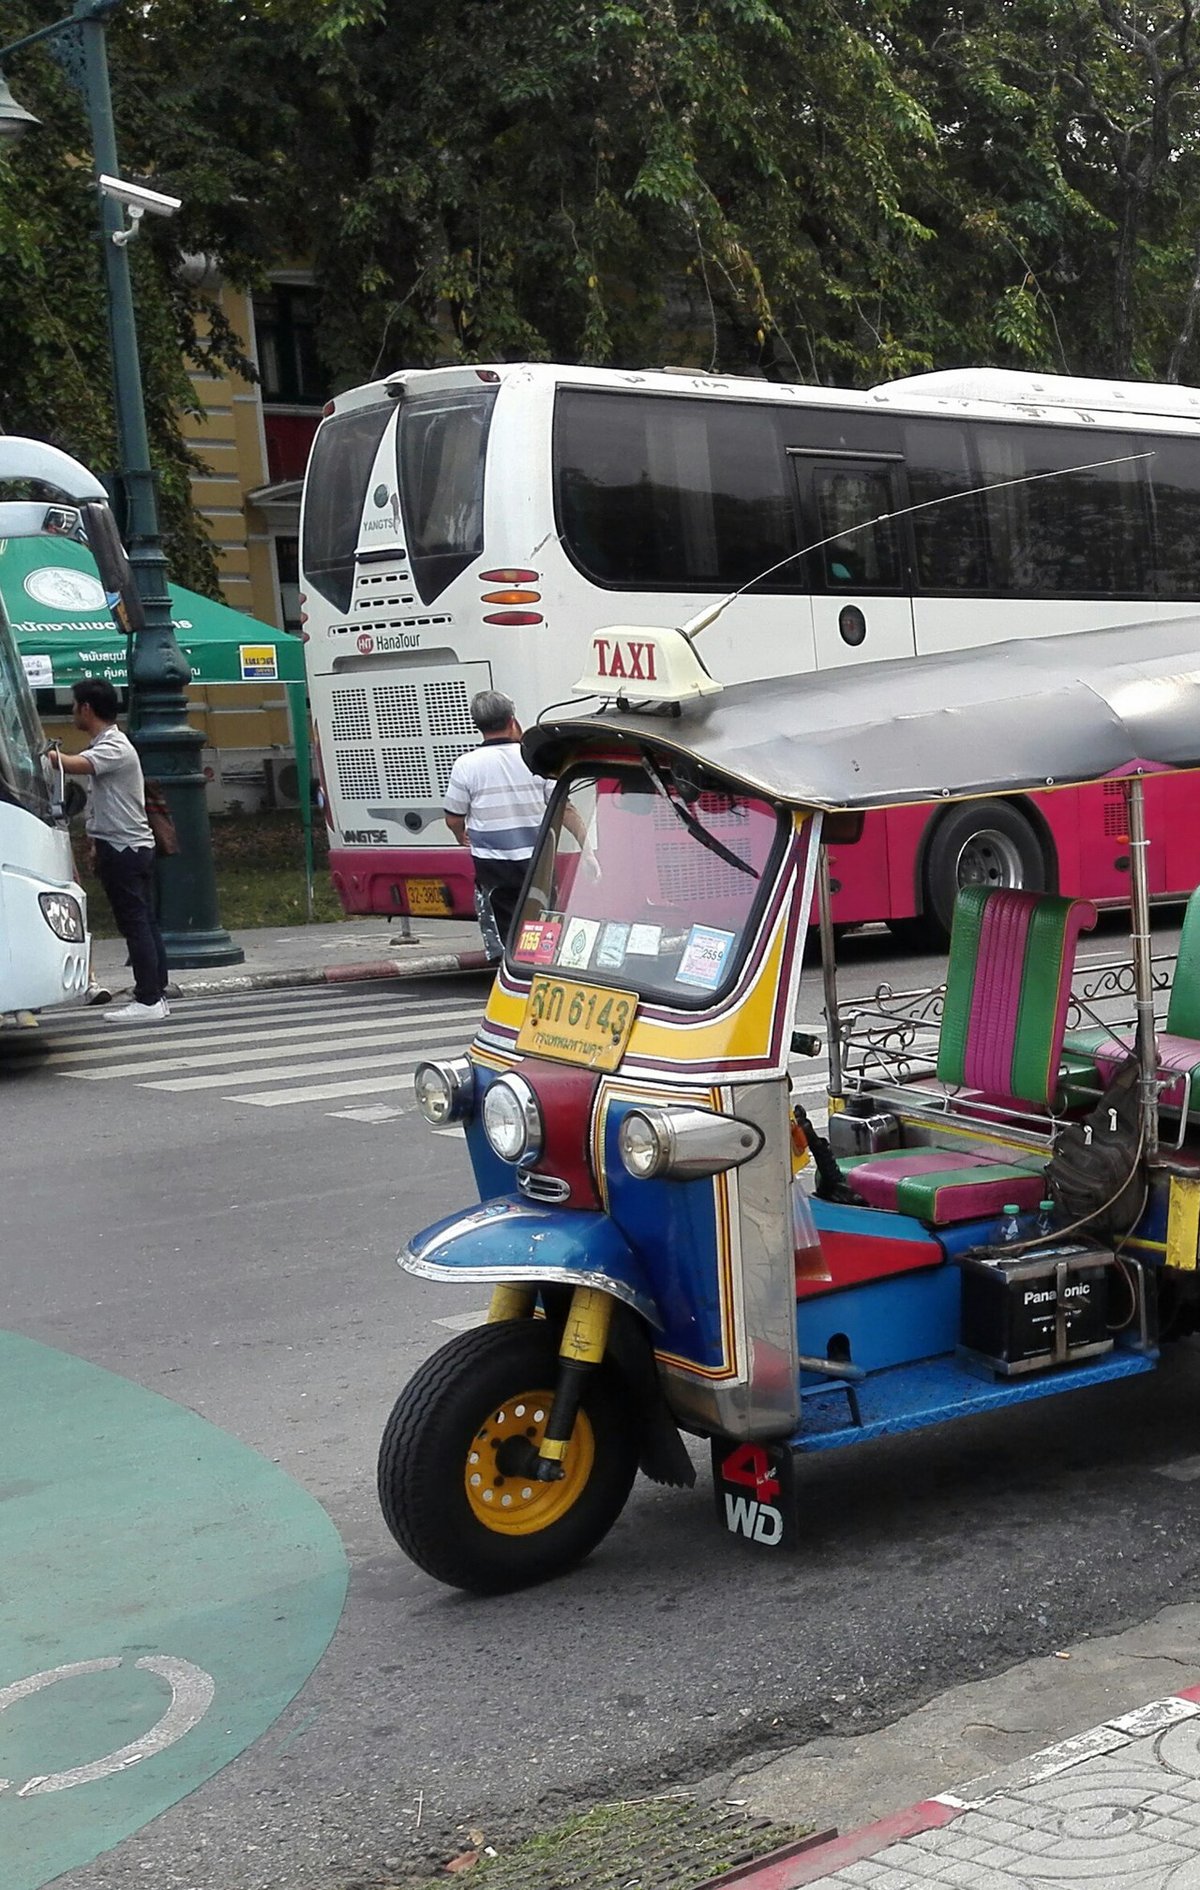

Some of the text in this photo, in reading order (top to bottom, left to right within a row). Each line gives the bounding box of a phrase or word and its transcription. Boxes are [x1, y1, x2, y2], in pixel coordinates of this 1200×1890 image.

[363, 518, 396, 531] YANGTS
[376, 633, 421, 651] HanaTour
[593, 638, 658, 681] TAXI
[519, 931, 541, 951] 1155
[701, 948, 724, 961] 2559
[568, 990, 630, 1036] 6143
[1023, 1282, 1091, 1305] Panaonic
[722, 1442, 781, 1504] 4
[724, 1492, 784, 1546] WD
